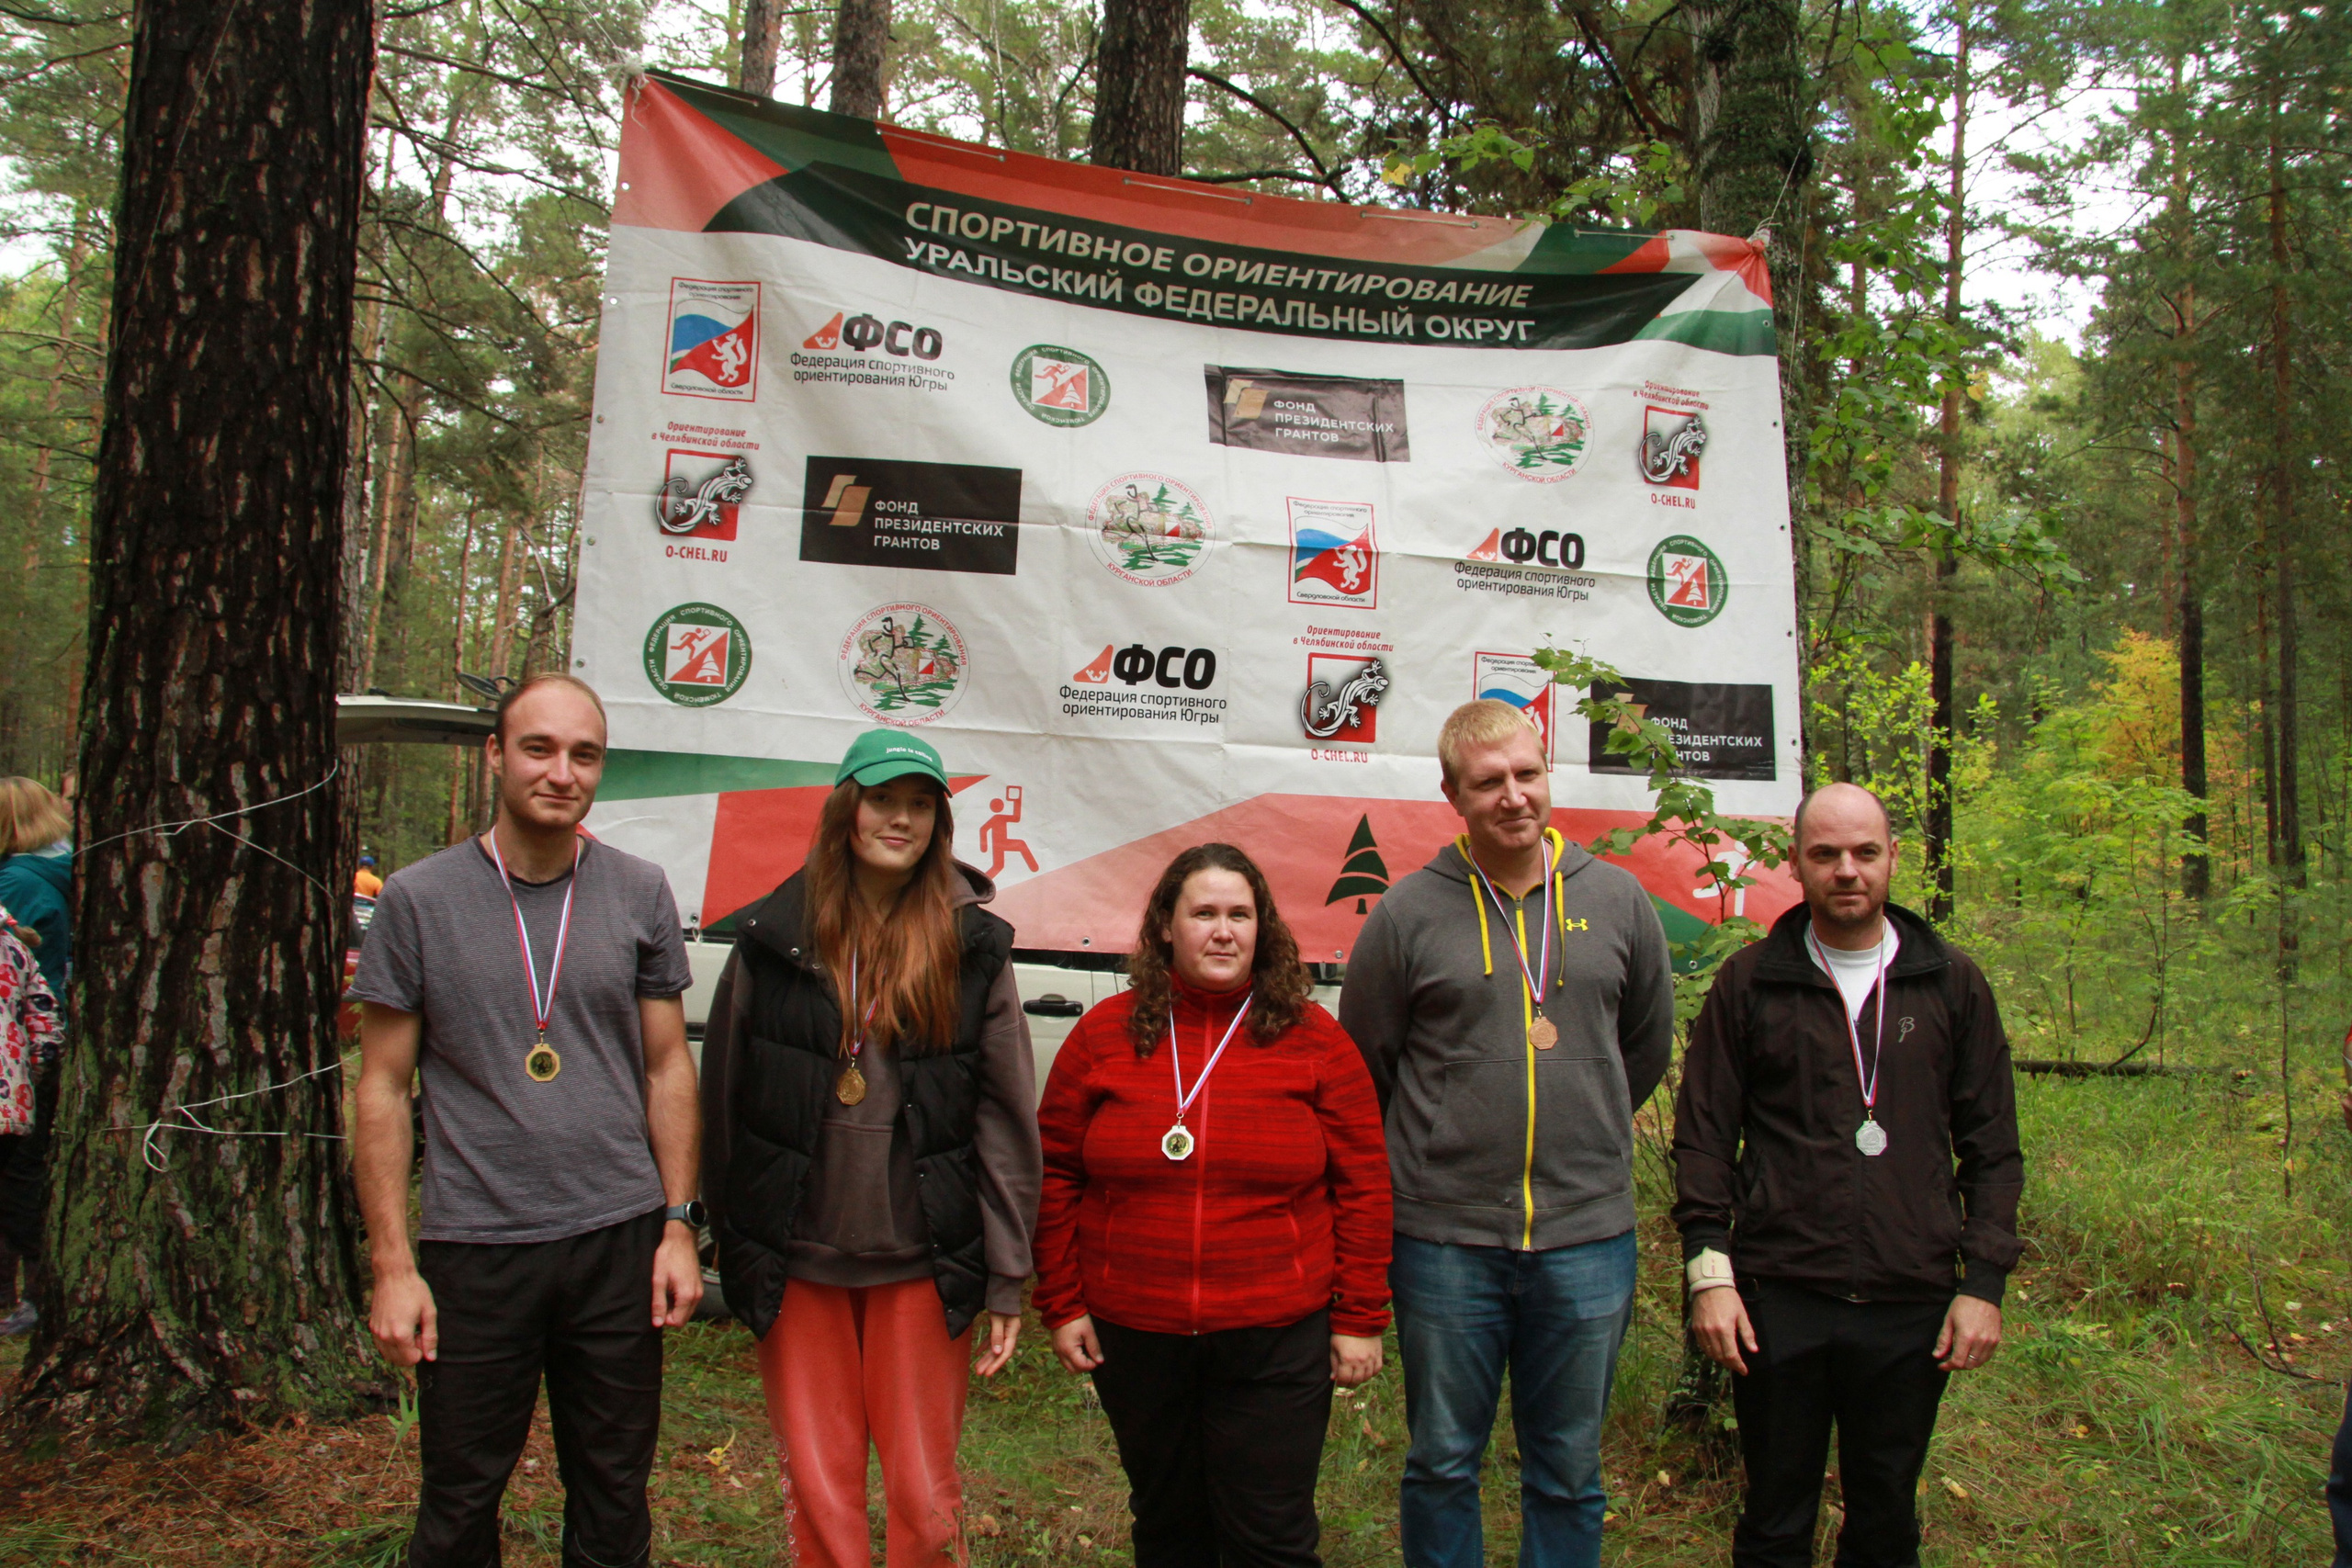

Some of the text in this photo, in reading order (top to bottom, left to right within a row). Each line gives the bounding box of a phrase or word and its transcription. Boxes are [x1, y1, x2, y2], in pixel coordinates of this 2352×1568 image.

[905, 202, 1533, 308] СПОРТИВНОЕ ОРИЕНТИРОВАНИЕ
[904, 236, 1535, 341] УРАЛЬСКИЙ ФЕДЕРАЛЬНЫЙ ОКРУГ
[842, 312, 943, 360] ФСО
[790, 352, 955, 380] Федерация спортивного
[794, 370, 947, 391] ориентирования Югры
[1645, 380, 1700, 397] Ориентирование
[1273, 399, 1317, 413] ФОНД
[667, 421, 746, 437] Ориентирование
[1274, 412, 1395, 433] ПРЕЗИДЕНТСКИХ
[660, 432, 718, 446] Челябинской
[720, 438, 760, 450] области
[1274, 427, 1340, 443] ГРАНТОВ
[1502, 461, 1577, 483] КУРГАНСКОЙ ОБЛАСТИ
[875, 500, 919, 515] ФОНД
[1088, 473, 1213, 529] ФЕДЕРАЦИЯ СПОРТИВНОГО ОРИЕНТИРОВАНИЯ
[1651, 493, 1696, 509] O-CHEL.RU
[875, 517, 1004, 537] ПРЕЗИДЕНТСКИХ
[874, 535, 941, 551] ГРАНТОВ
[1500, 527, 1585, 570] ФСО
[665, 545, 728, 563] O-CHEL.RU
[1107, 561, 1193, 586] КУРГАНСКОЙ ОБЛАСТИ
[1454, 561, 1595, 588] Федерация спортивного
[1457, 578, 1589, 602] ориентирования Югры
[841, 604, 967, 666] ФЕДЕРАЦИЯ СПОРТИВНОГО ОРИЕНТИРОВАНИЯ
[1307, 625, 1381, 639] Ориентирование
[649, 607, 747, 692] ФЕДЕРАЦИЯ СПОРТИВНОГО ОРИЕНТИРОВАНИЯ
[1300, 636, 1354, 649] Челябинской
[1356, 641, 1394, 651] области
[1113, 643, 1216, 690] ФСО
[1059, 684, 1227, 709] Федерация спортивного
[859, 703, 945, 727] КУРГАНСКОЙ ОБЛАСТИ
[1062, 703, 1219, 726] ориентирования Югры
[1661, 734, 1762, 747] ЕЗИДЕНТСКИХ
[1311, 749, 1368, 763] O-CHEL.RU
